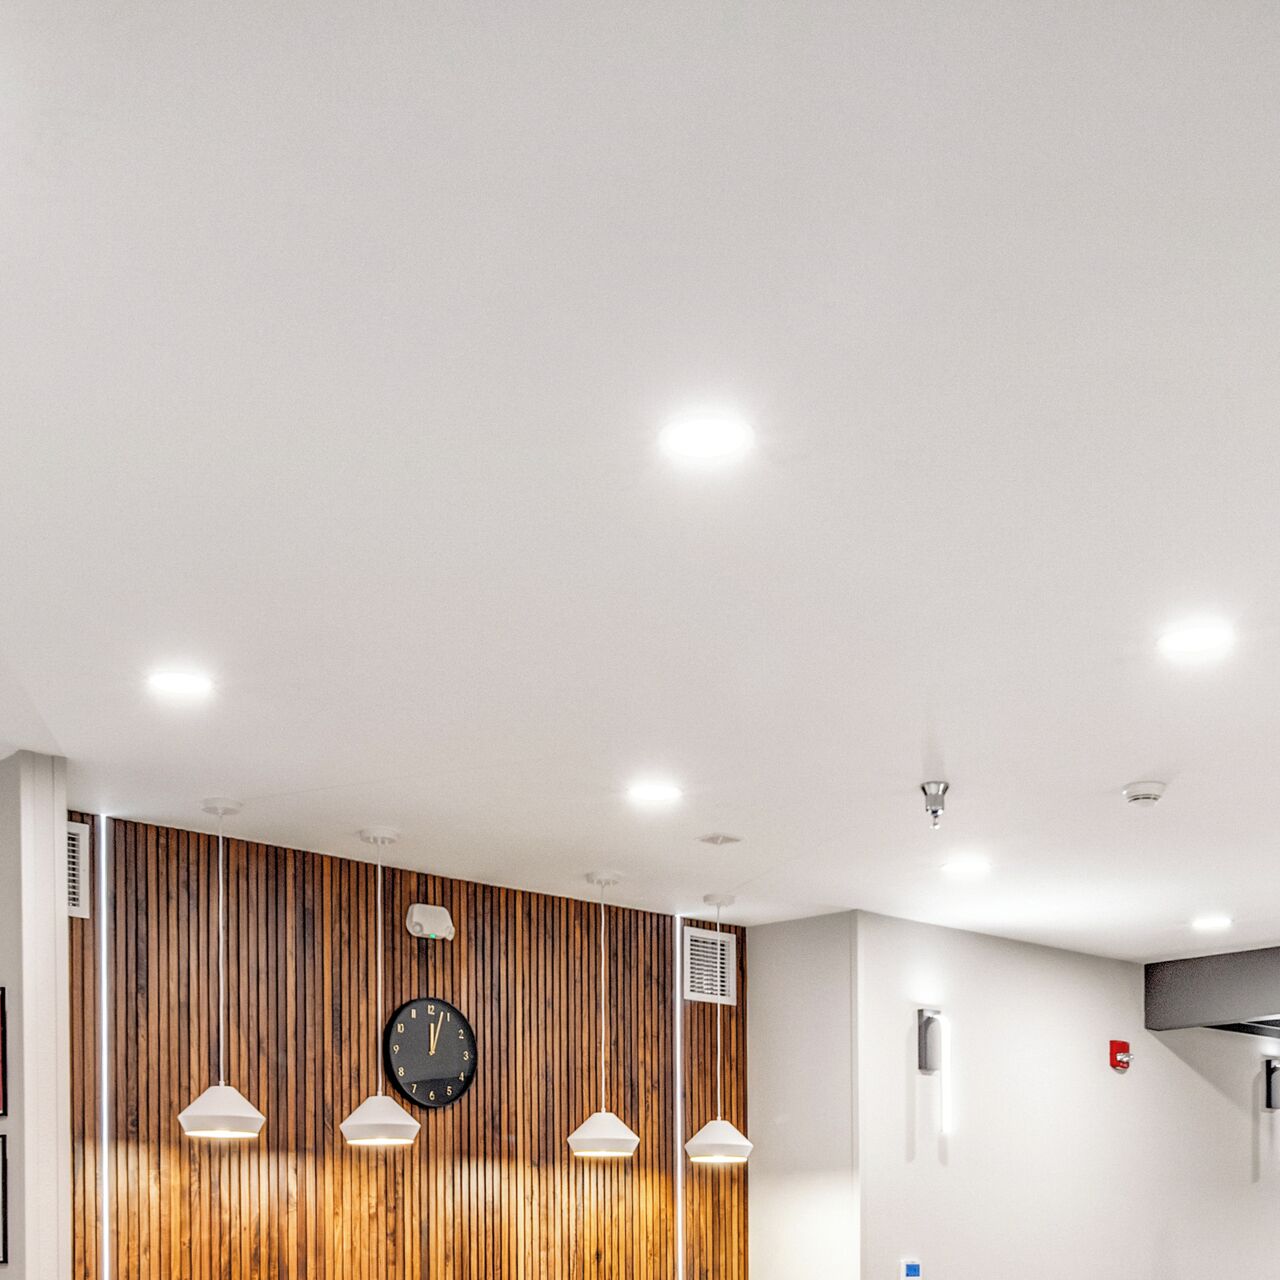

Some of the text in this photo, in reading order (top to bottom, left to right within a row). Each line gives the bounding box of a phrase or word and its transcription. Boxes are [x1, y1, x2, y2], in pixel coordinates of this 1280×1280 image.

[411, 1009, 417, 1018] 11
[427, 1005, 435, 1015] 12
[446, 1013, 451, 1021] 1
[397, 1024, 405, 1033] 10
[459, 1030, 464, 1039] 2
[393, 1045, 400, 1054] 9
[463, 1051, 469, 1061] 3
[398, 1067, 405, 1076] 8
[459, 1072, 465, 1081] 4
[412, 1084, 417, 1094] 7
[446, 1086, 452, 1095] 5
[429, 1091, 435, 1100] 6
